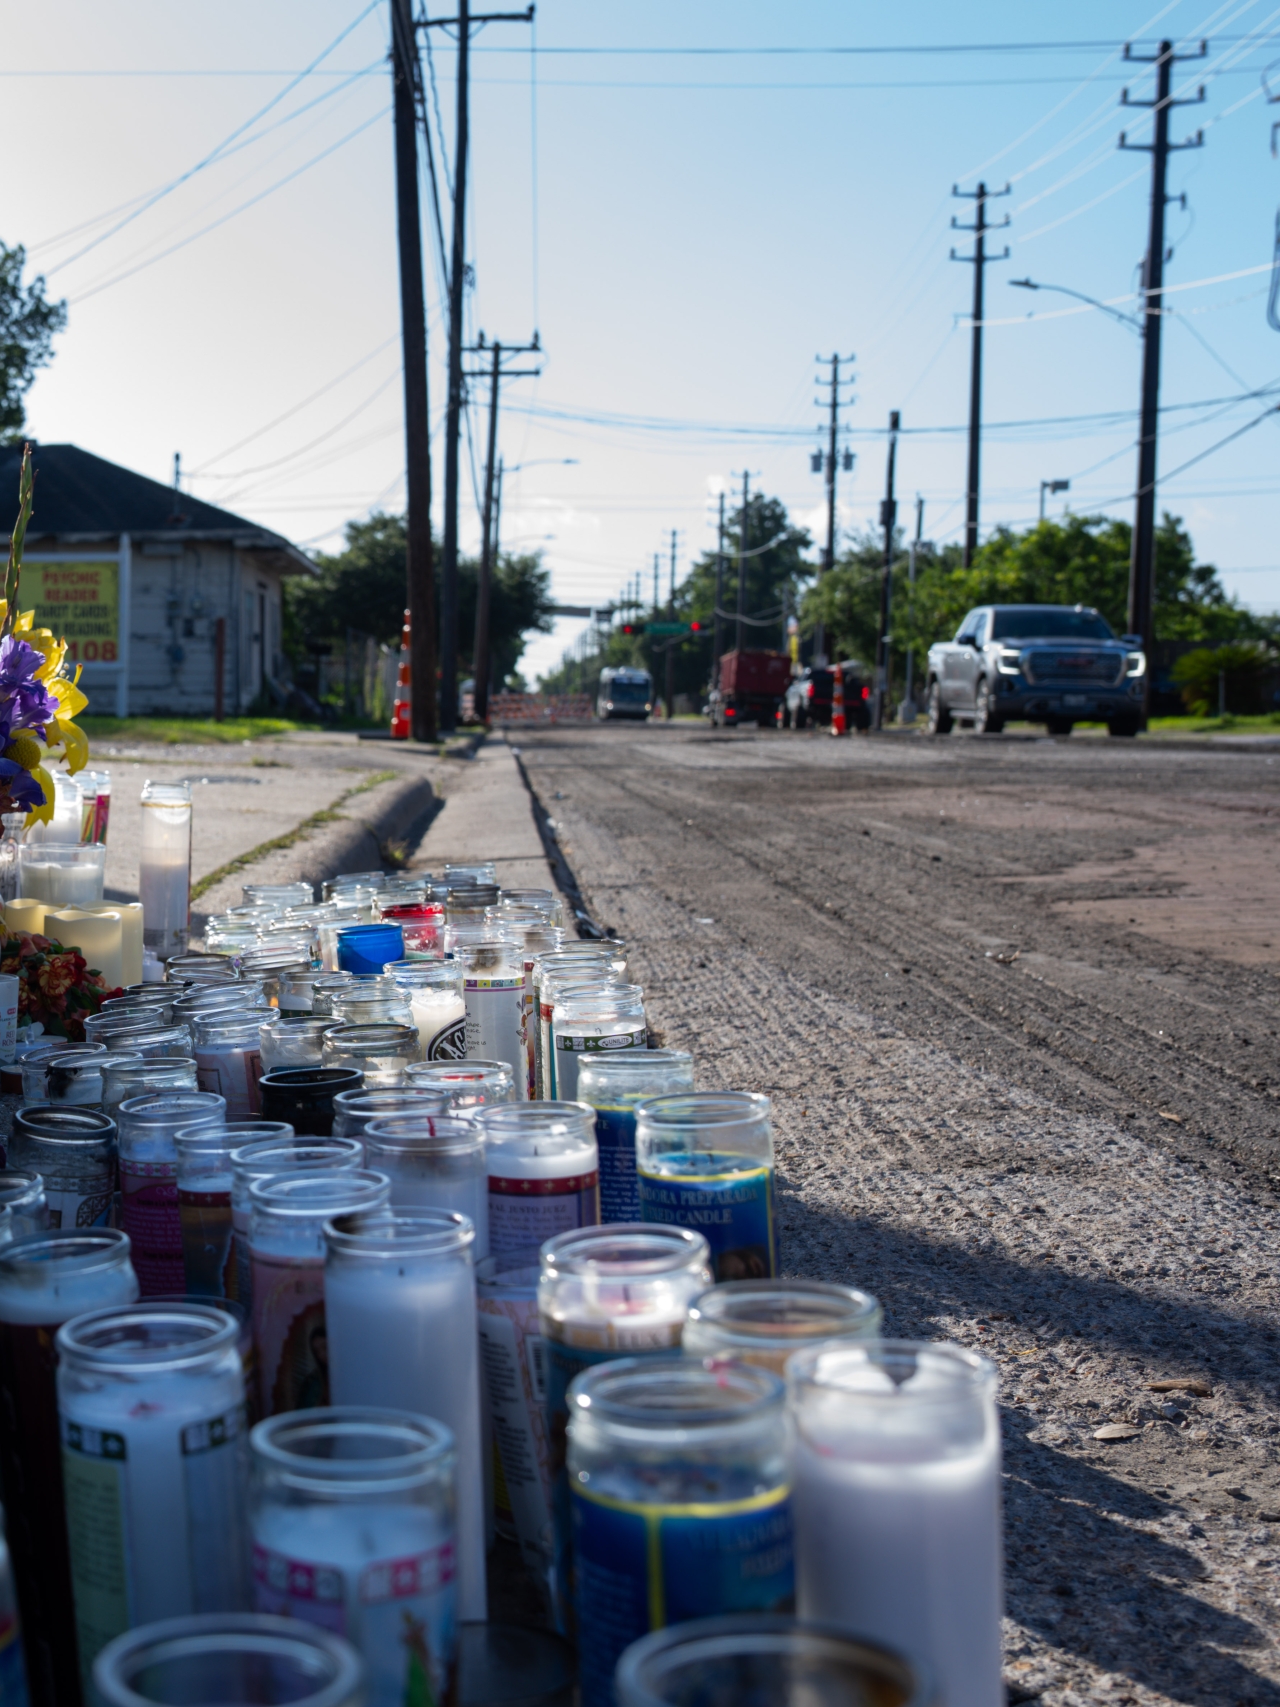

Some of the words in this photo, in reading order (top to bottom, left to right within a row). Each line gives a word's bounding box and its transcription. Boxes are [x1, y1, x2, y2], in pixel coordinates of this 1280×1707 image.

[73, 605, 108, 617] CARDS
[609, 1036, 629, 1045] UNILITE
[680, 1186, 758, 1206] PREPARADA
[509, 1205, 538, 1213] JUSTO
[542, 1205, 566, 1213] JUEZ
[676, 1208, 733, 1225] CANDLE
